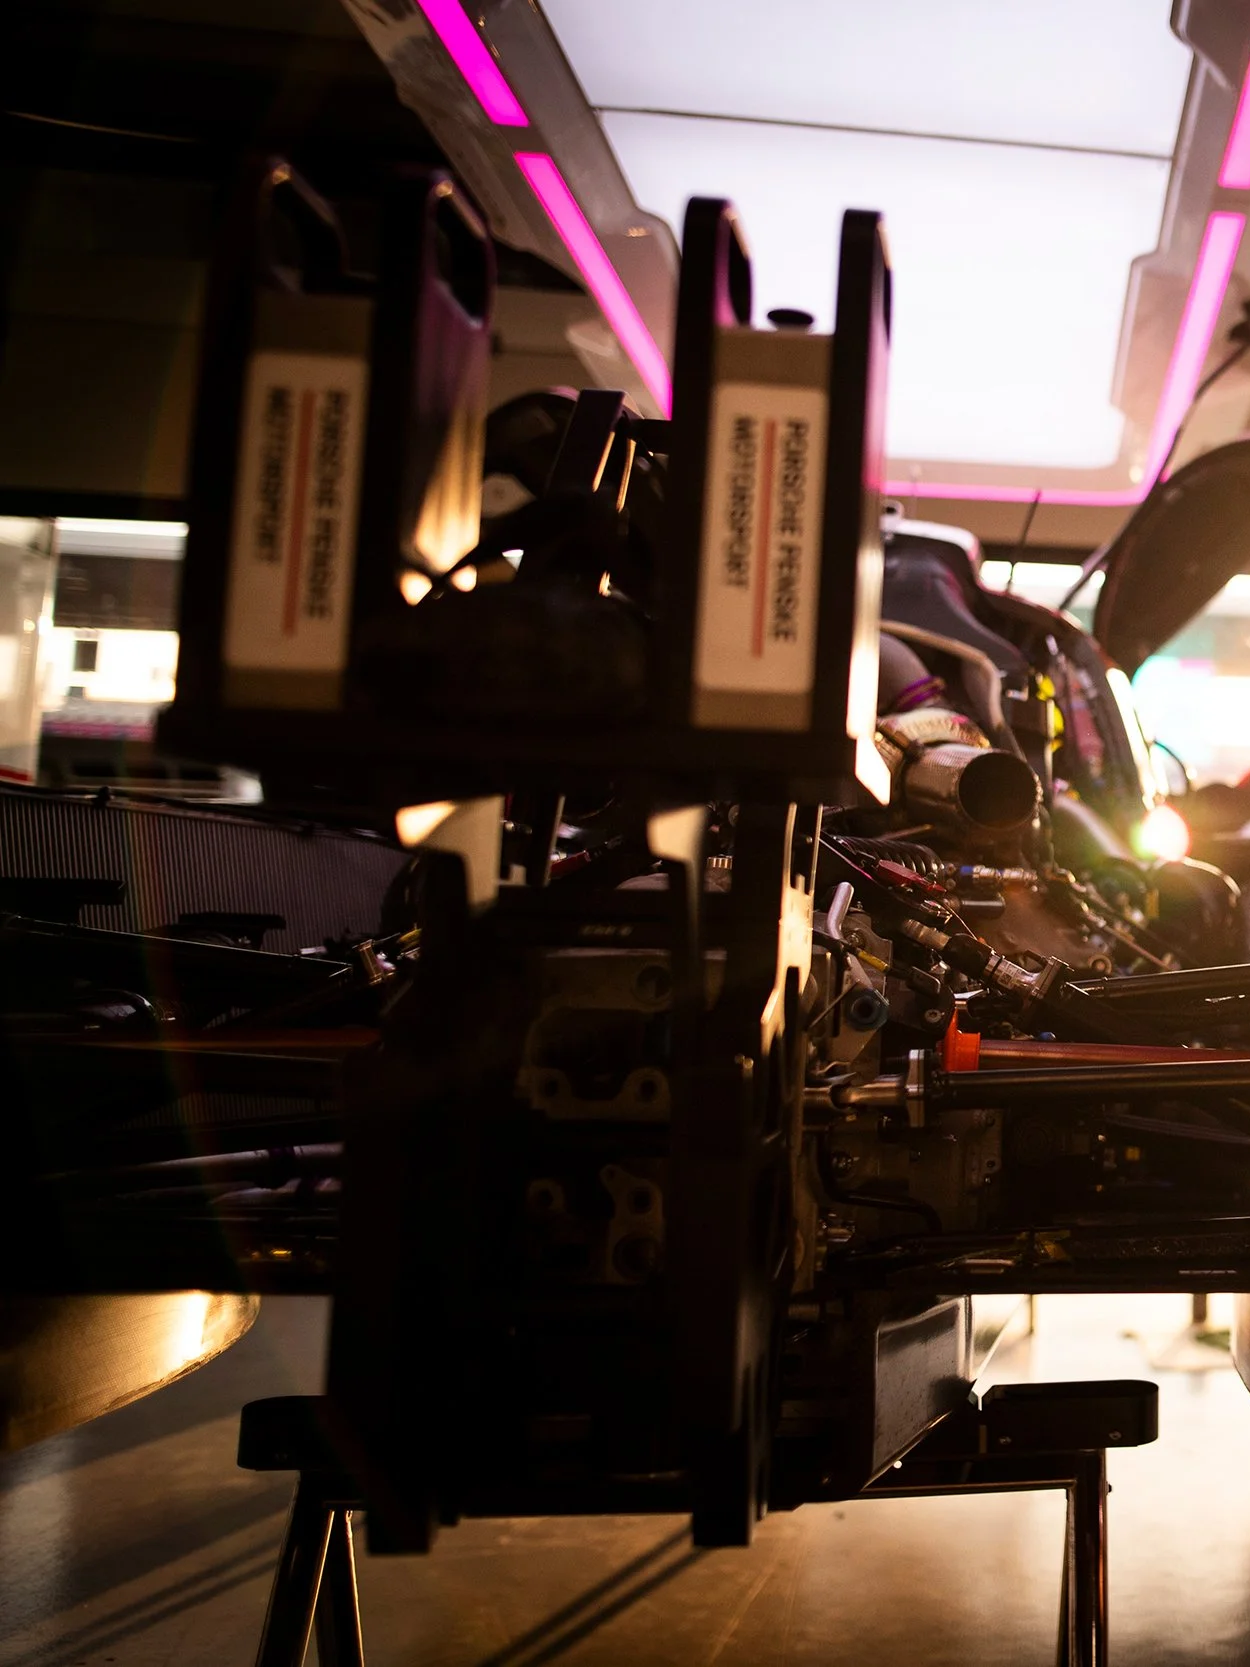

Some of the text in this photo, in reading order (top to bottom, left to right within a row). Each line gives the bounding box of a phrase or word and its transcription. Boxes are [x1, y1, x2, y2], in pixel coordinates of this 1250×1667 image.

[256, 385, 291, 564] MOTORSPORT
[317, 390, 347, 508] PORSCHE
[726, 415, 755, 588] MOTORSPORT
[771, 419, 809, 643] PORSCHE PENSKE
